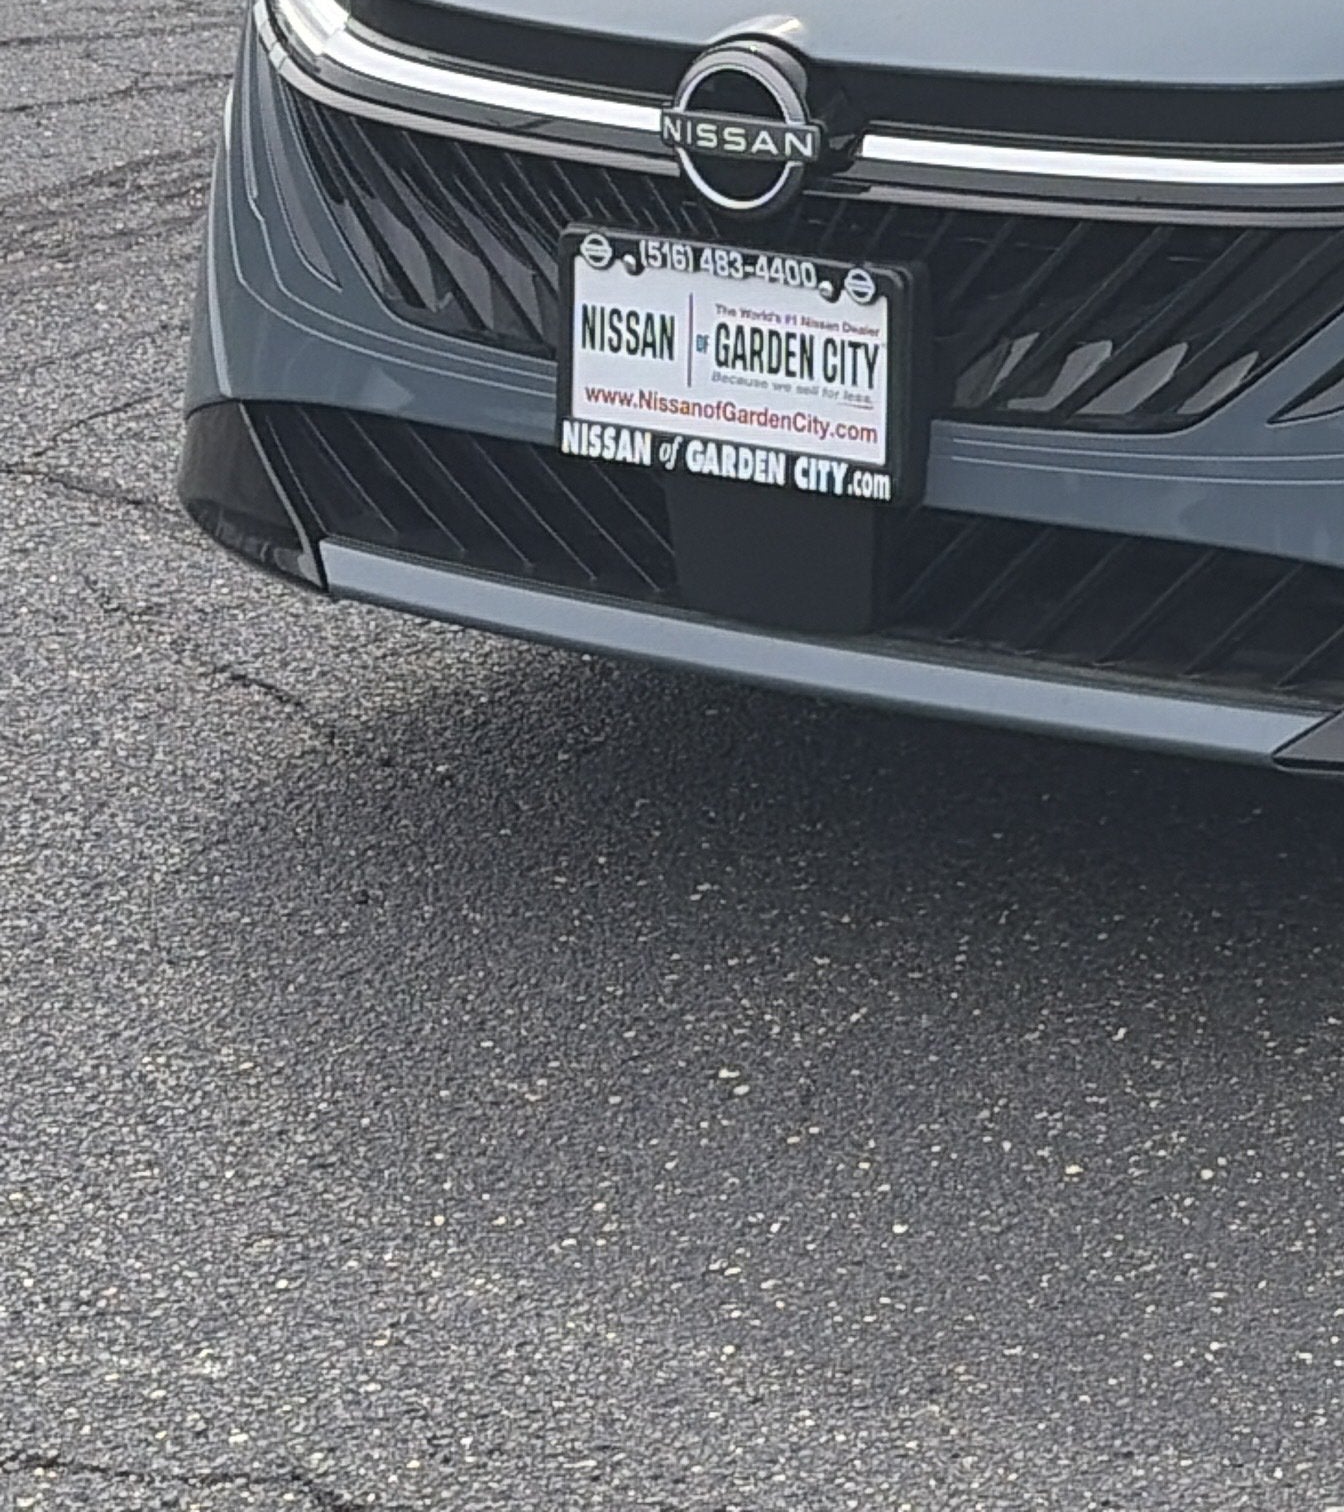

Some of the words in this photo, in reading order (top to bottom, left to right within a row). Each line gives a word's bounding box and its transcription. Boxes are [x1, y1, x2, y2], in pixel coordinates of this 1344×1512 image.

[662, 115, 813, 158] NISSAN
[640, 239, 694, 273] (516)
[700, 247, 818, 289] 483-4400
[715, 303, 737, 318] The
[740, 307, 782, 324] World's
[801, 315, 840, 333] Nissan
[842, 321, 881, 338] Dealer
[581, 303, 675, 361] NISSAN
[715, 322, 814, 381] GARDEN
[823, 337, 880, 390] CITY
[711, 371, 769, 389] Because
[771, 380, 792, 392] we
[796, 384, 818, 397] sell
[822, 387, 839, 400] for
[585, 386, 878, 444] www.NissanofGardenCity.com
[561, 419, 652, 466] NISSAN
[658, 436, 684, 471] of
[686, 440, 786, 486] GARDEN
